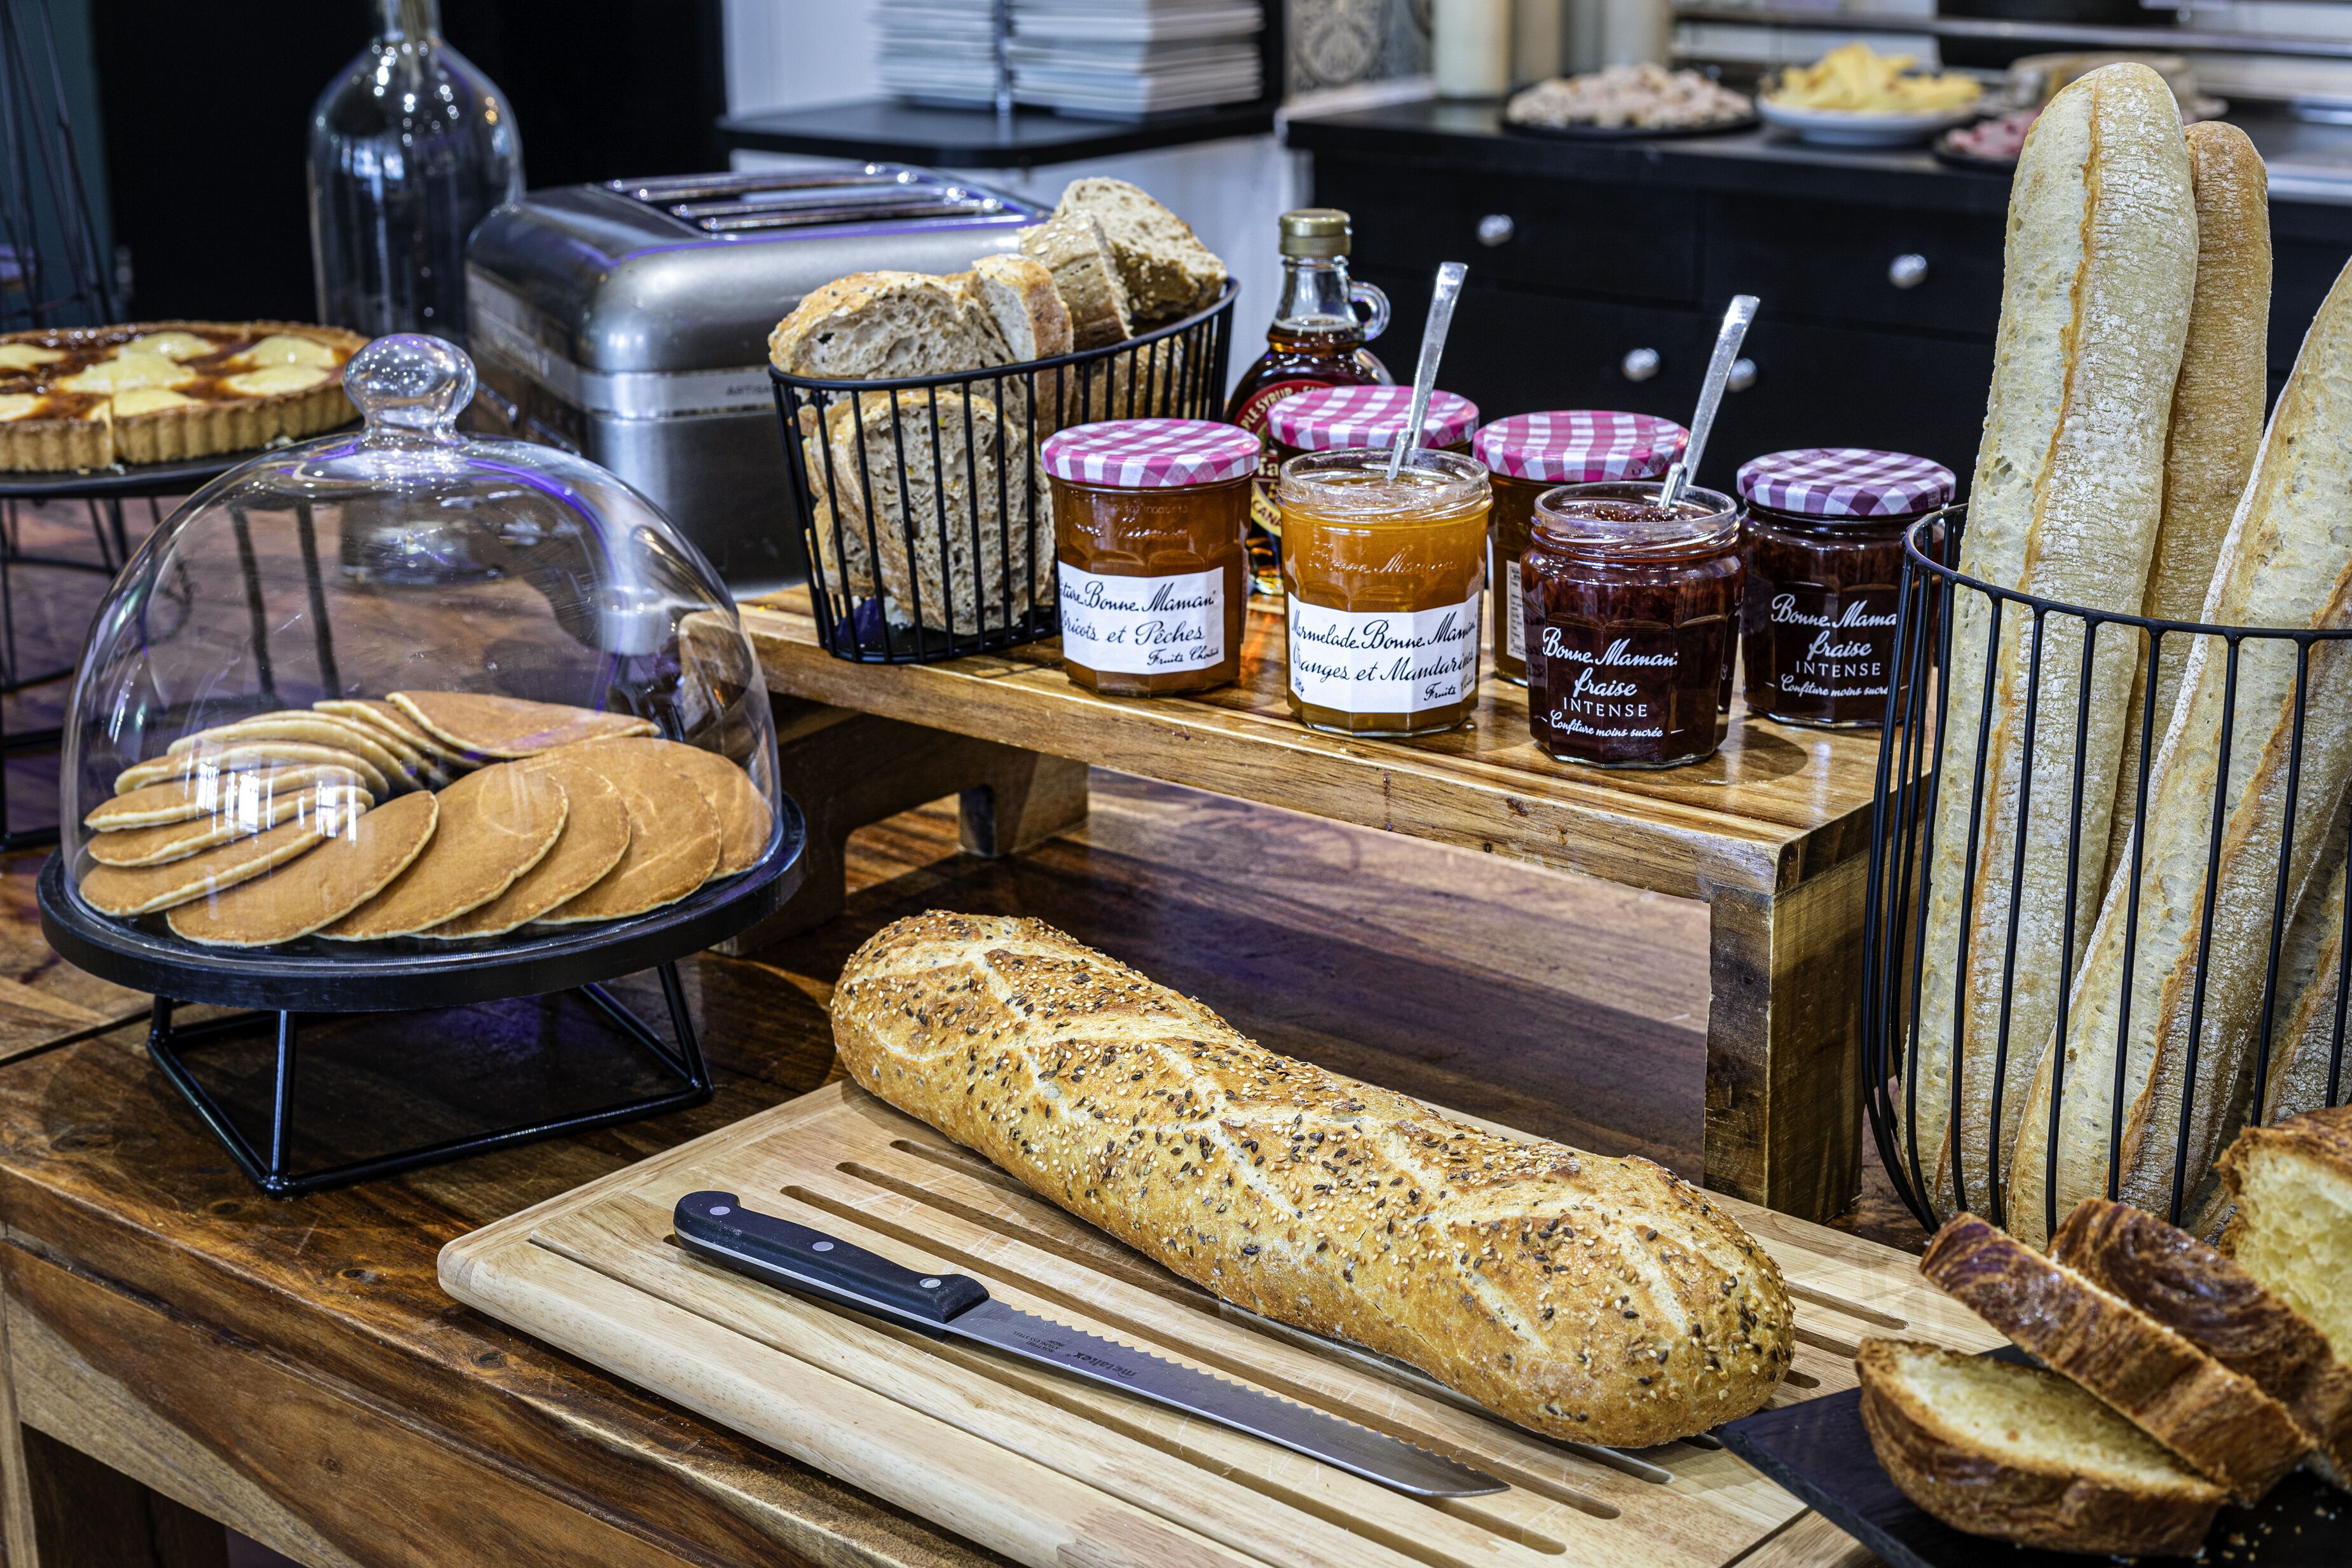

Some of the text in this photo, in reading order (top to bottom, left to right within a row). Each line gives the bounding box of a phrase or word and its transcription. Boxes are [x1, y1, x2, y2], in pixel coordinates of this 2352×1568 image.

[1084, 581, 1140, 611] Bonne
[1142, 582, 1215, 612] Maman
[1771, 594, 1897, 628] Bonne Mama
[1062, 610, 1205, 646] bricots et Pêches
[1291, 609, 1359, 648] Marmelade
[1362, 619, 1425, 649] Bonne
[1147, 648, 1184, 665] Fruits
[1543, 627, 1594, 664] Bonne
[1595, 638, 1678, 667] Maman
[1807, 630, 1872, 660] fraise
[1294, 642, 1473, 683] Oranges et Mandarines
[1796, 660, 1881, 678] INTENSE
[1424, 681, 1456, 700] Fruits
[1573, 667, 1638, 698] fraise
[1781, 674, 1829, 697] Confiture
[1831, 687, 1863, 697] moins
[1564, 697, 1647, 717] INTENSE
[1550, 709, 1663, 737] Confiture moins sucrée
[1013, 1331, 1060, 1350] STAINLESS STEEL
[1073, 1351, 1137, 1379] metaltex
